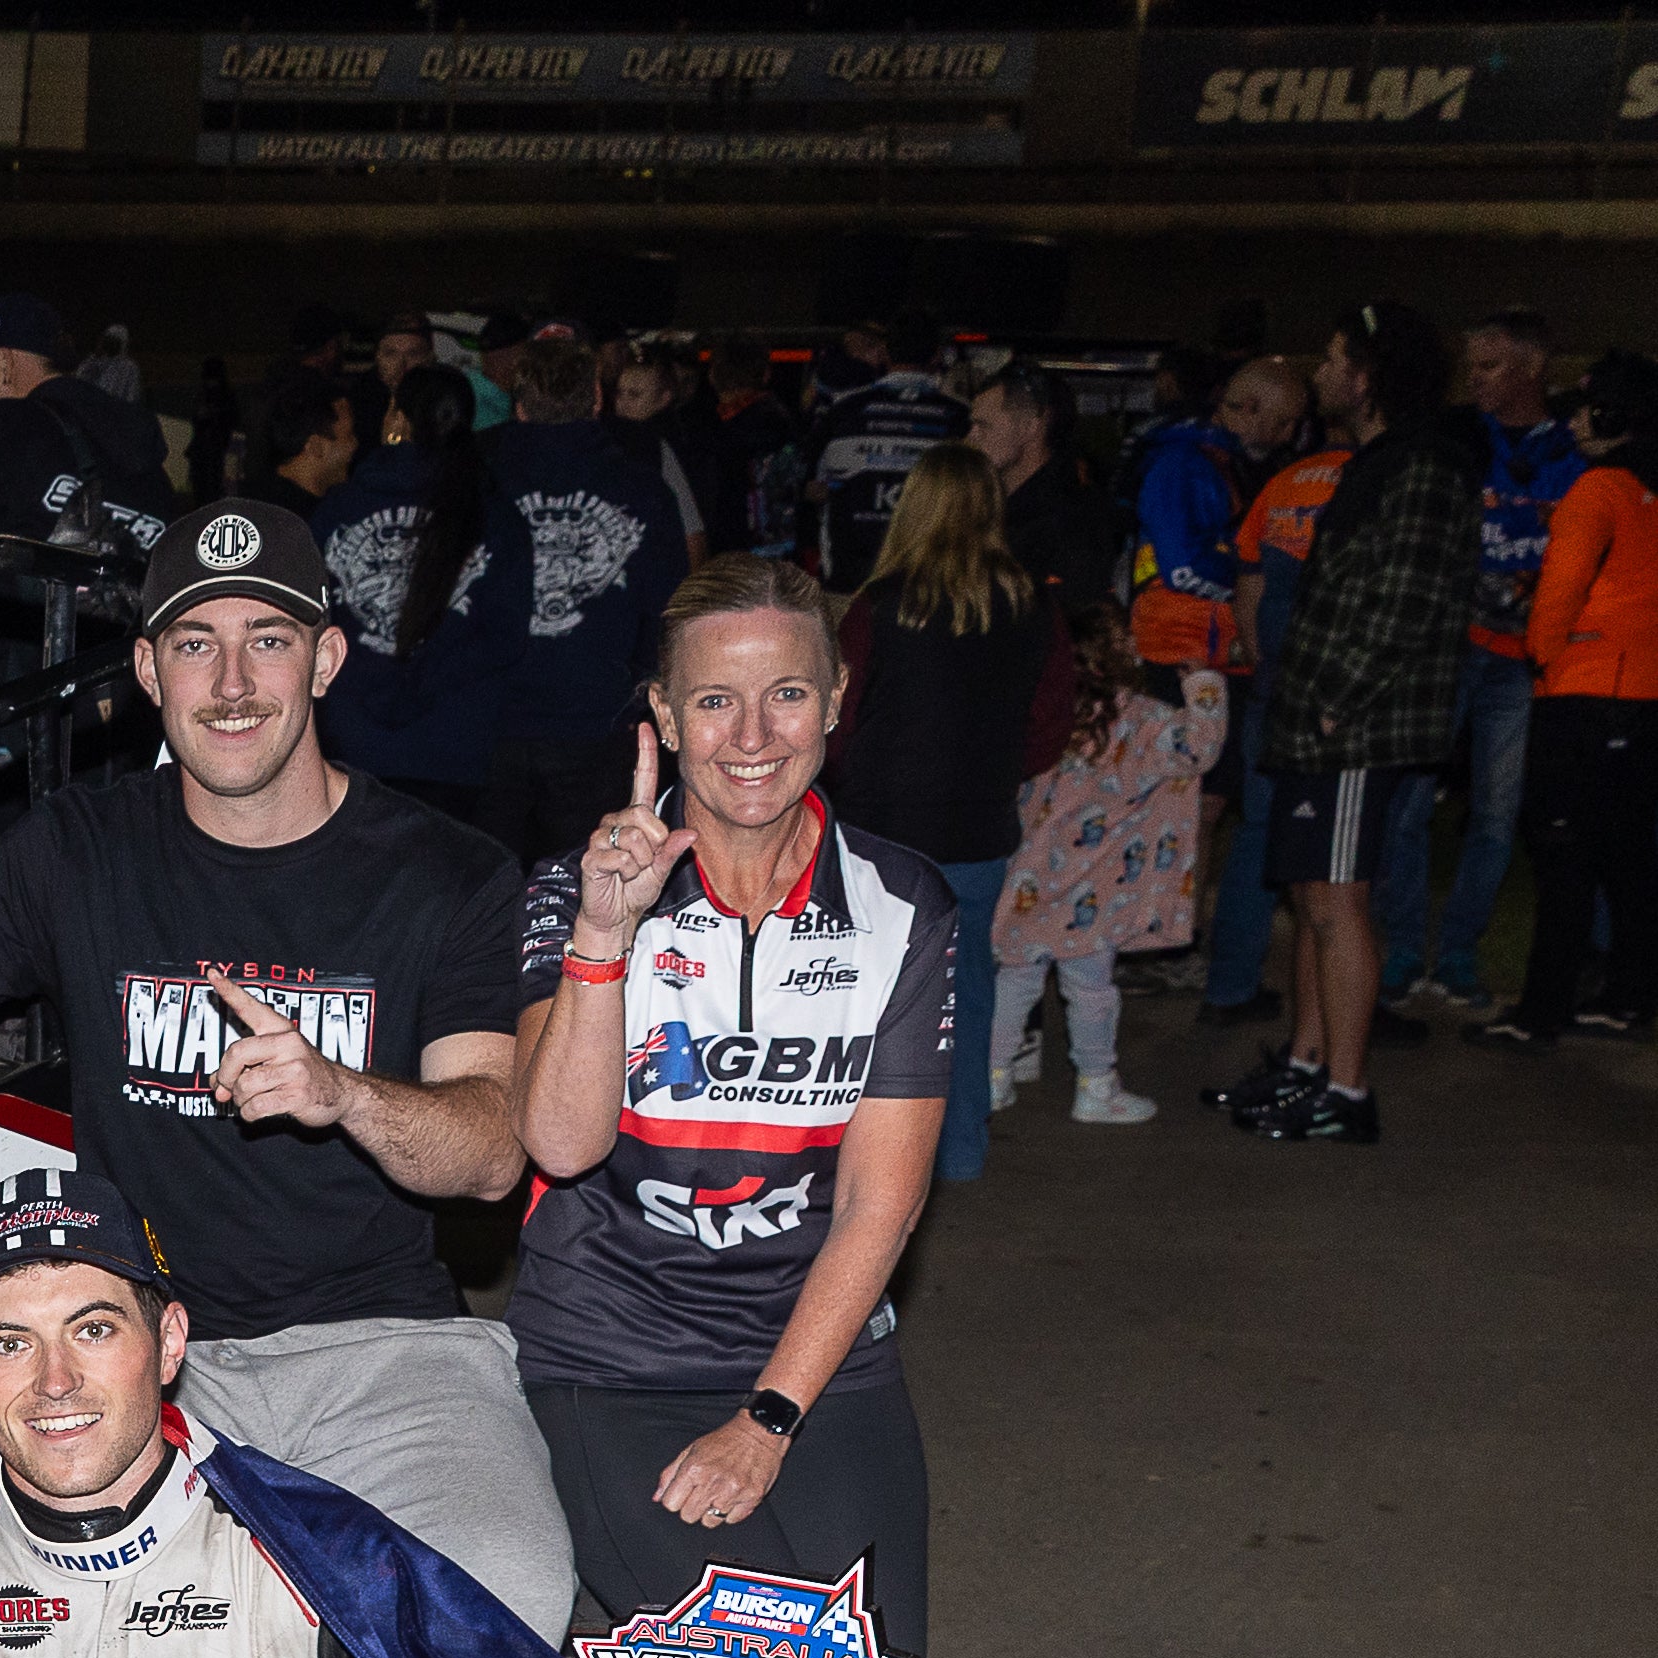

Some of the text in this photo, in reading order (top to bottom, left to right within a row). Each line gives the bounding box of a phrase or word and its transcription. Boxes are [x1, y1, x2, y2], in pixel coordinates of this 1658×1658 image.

[195, 959, 316, 985] TYSON
[706, 1034, 874, 1084] GBM
[707, 1085, 862, 1107] CONSULTING
[20, 1200, 63, 1214] PERTH
[24, 1525, 159, 1573] WINNER
[124, 1583, 232, 1638] James
[712, 1588, 817, 1626] BURSON
[174, 1622, 230, 1632] TRANSPORT
[724, 1613, 793, 1634] AUTO PARTS
